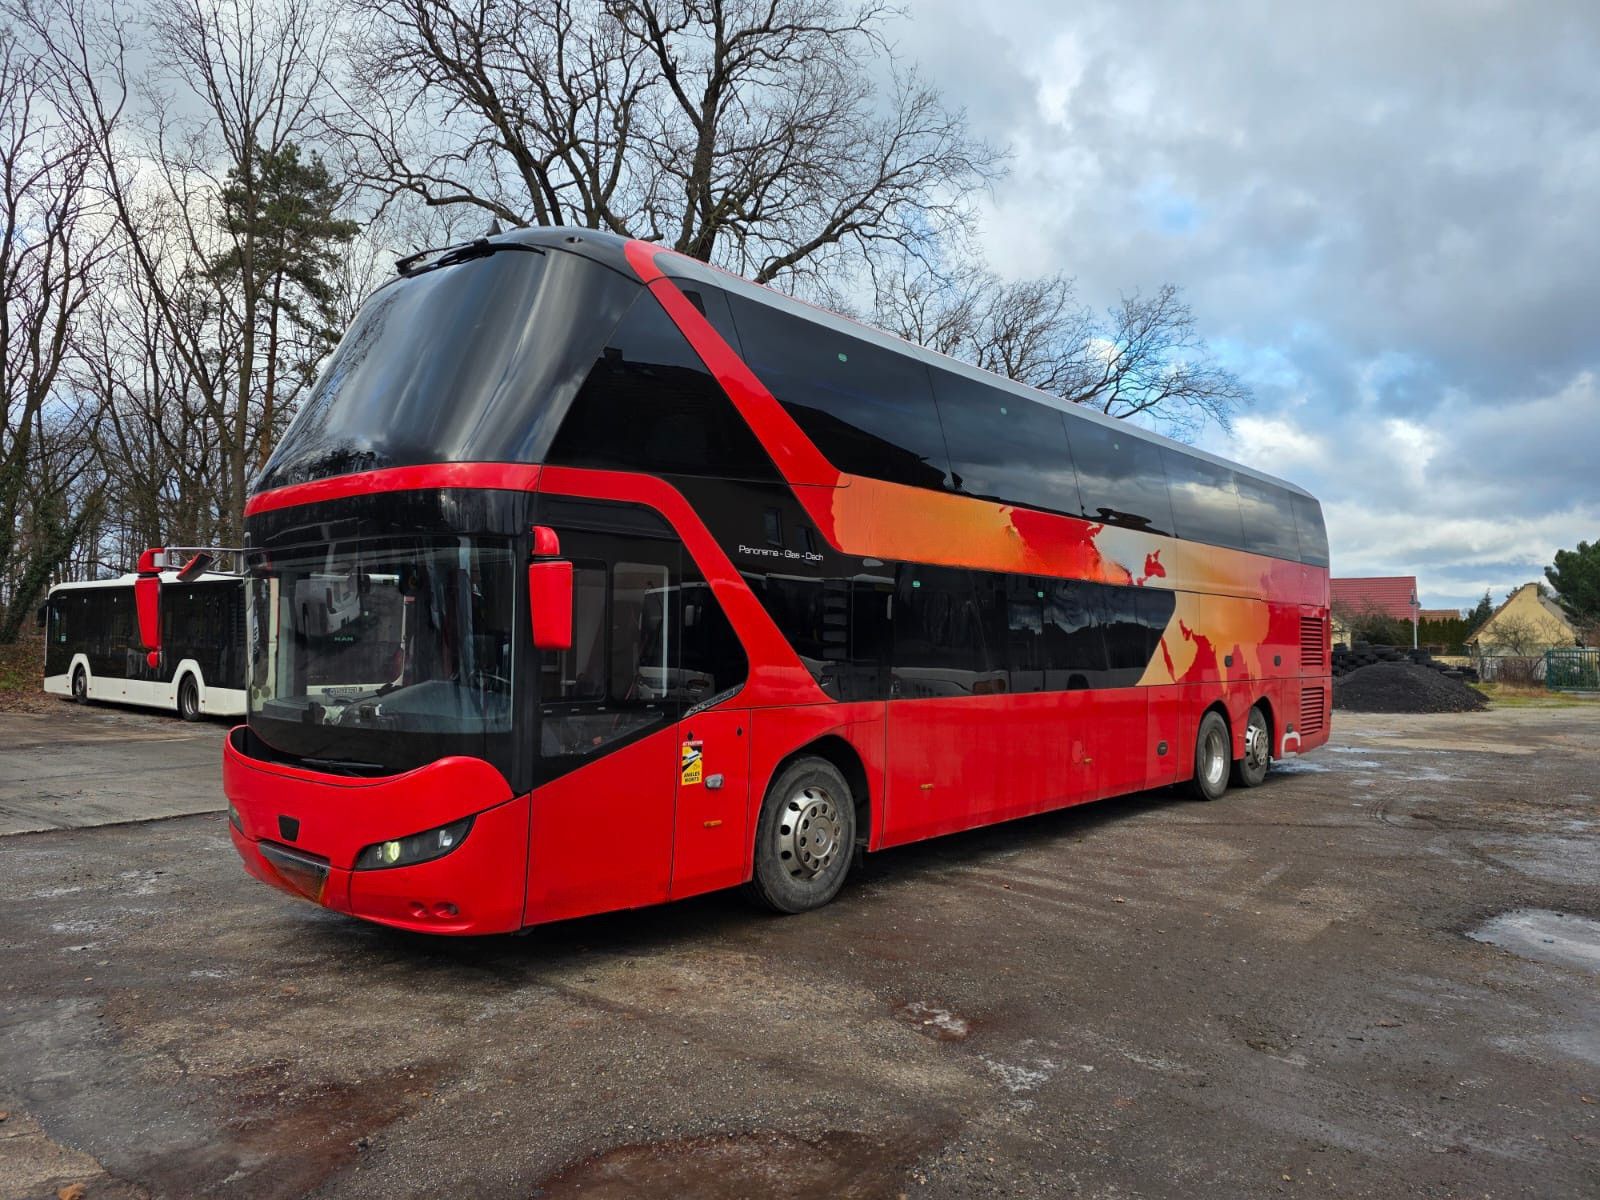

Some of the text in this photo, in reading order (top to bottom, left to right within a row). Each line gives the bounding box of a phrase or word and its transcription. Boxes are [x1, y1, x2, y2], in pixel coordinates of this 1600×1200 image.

[738, 545, 778, 557] Panorama
[784, 549, 800, 559] Glas
[805, 551, 824, 561] Dach
